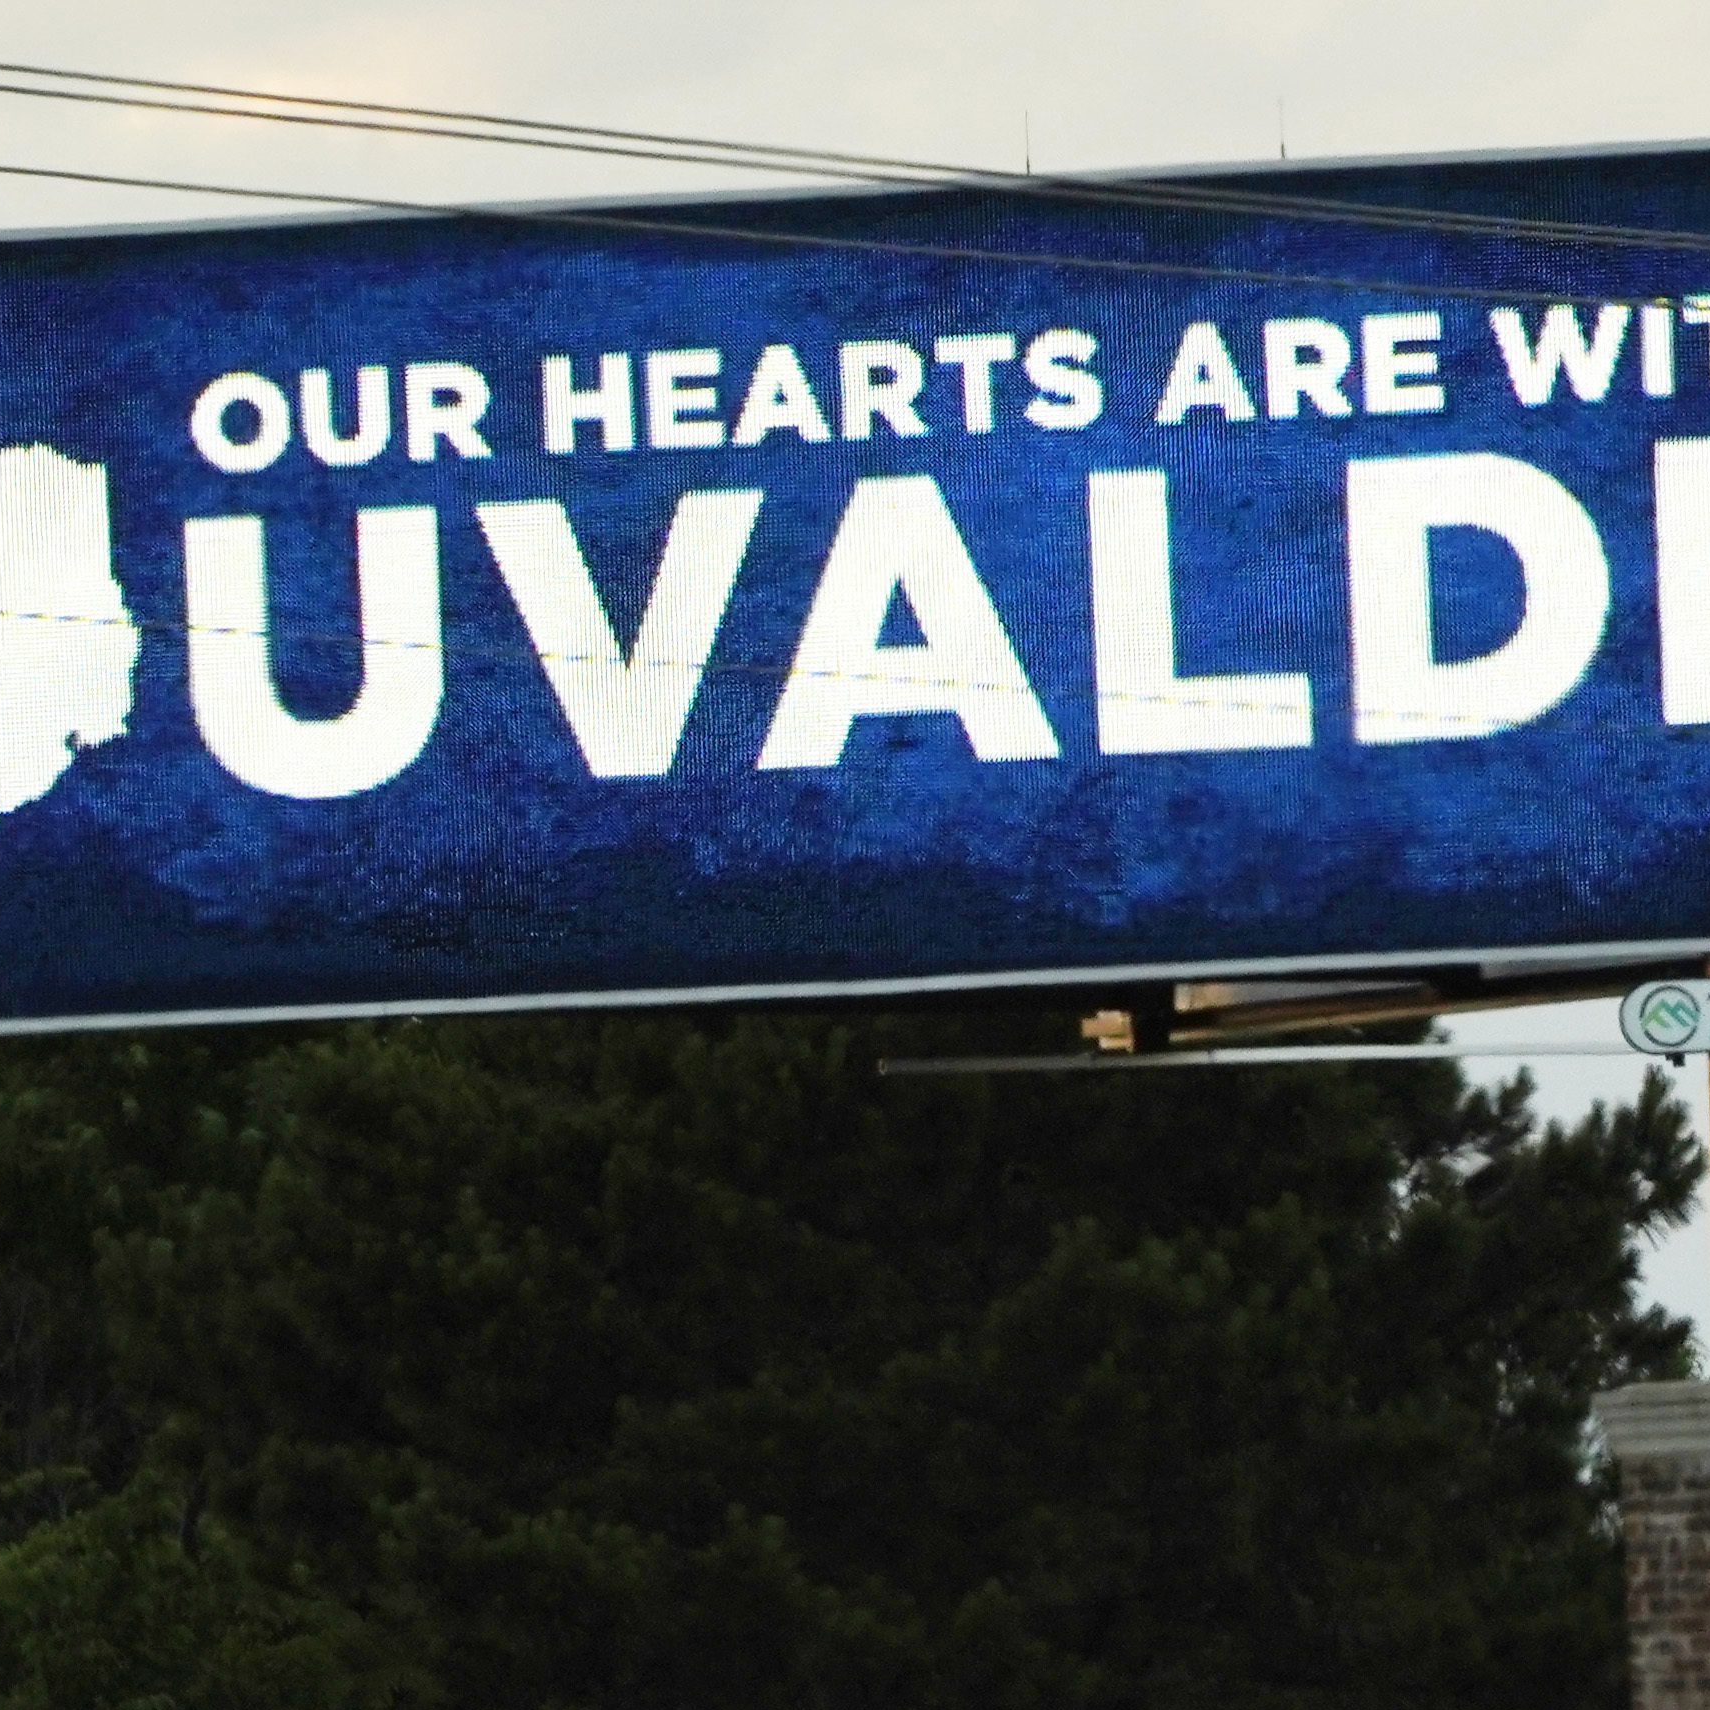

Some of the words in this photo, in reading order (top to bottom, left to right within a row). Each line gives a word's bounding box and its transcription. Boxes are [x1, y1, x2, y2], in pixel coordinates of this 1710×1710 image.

[191, 362, 492, 474] OUR
[542, 328, 1104, 455] HEARTS
[1155, 311, 1445, 427] ARE
